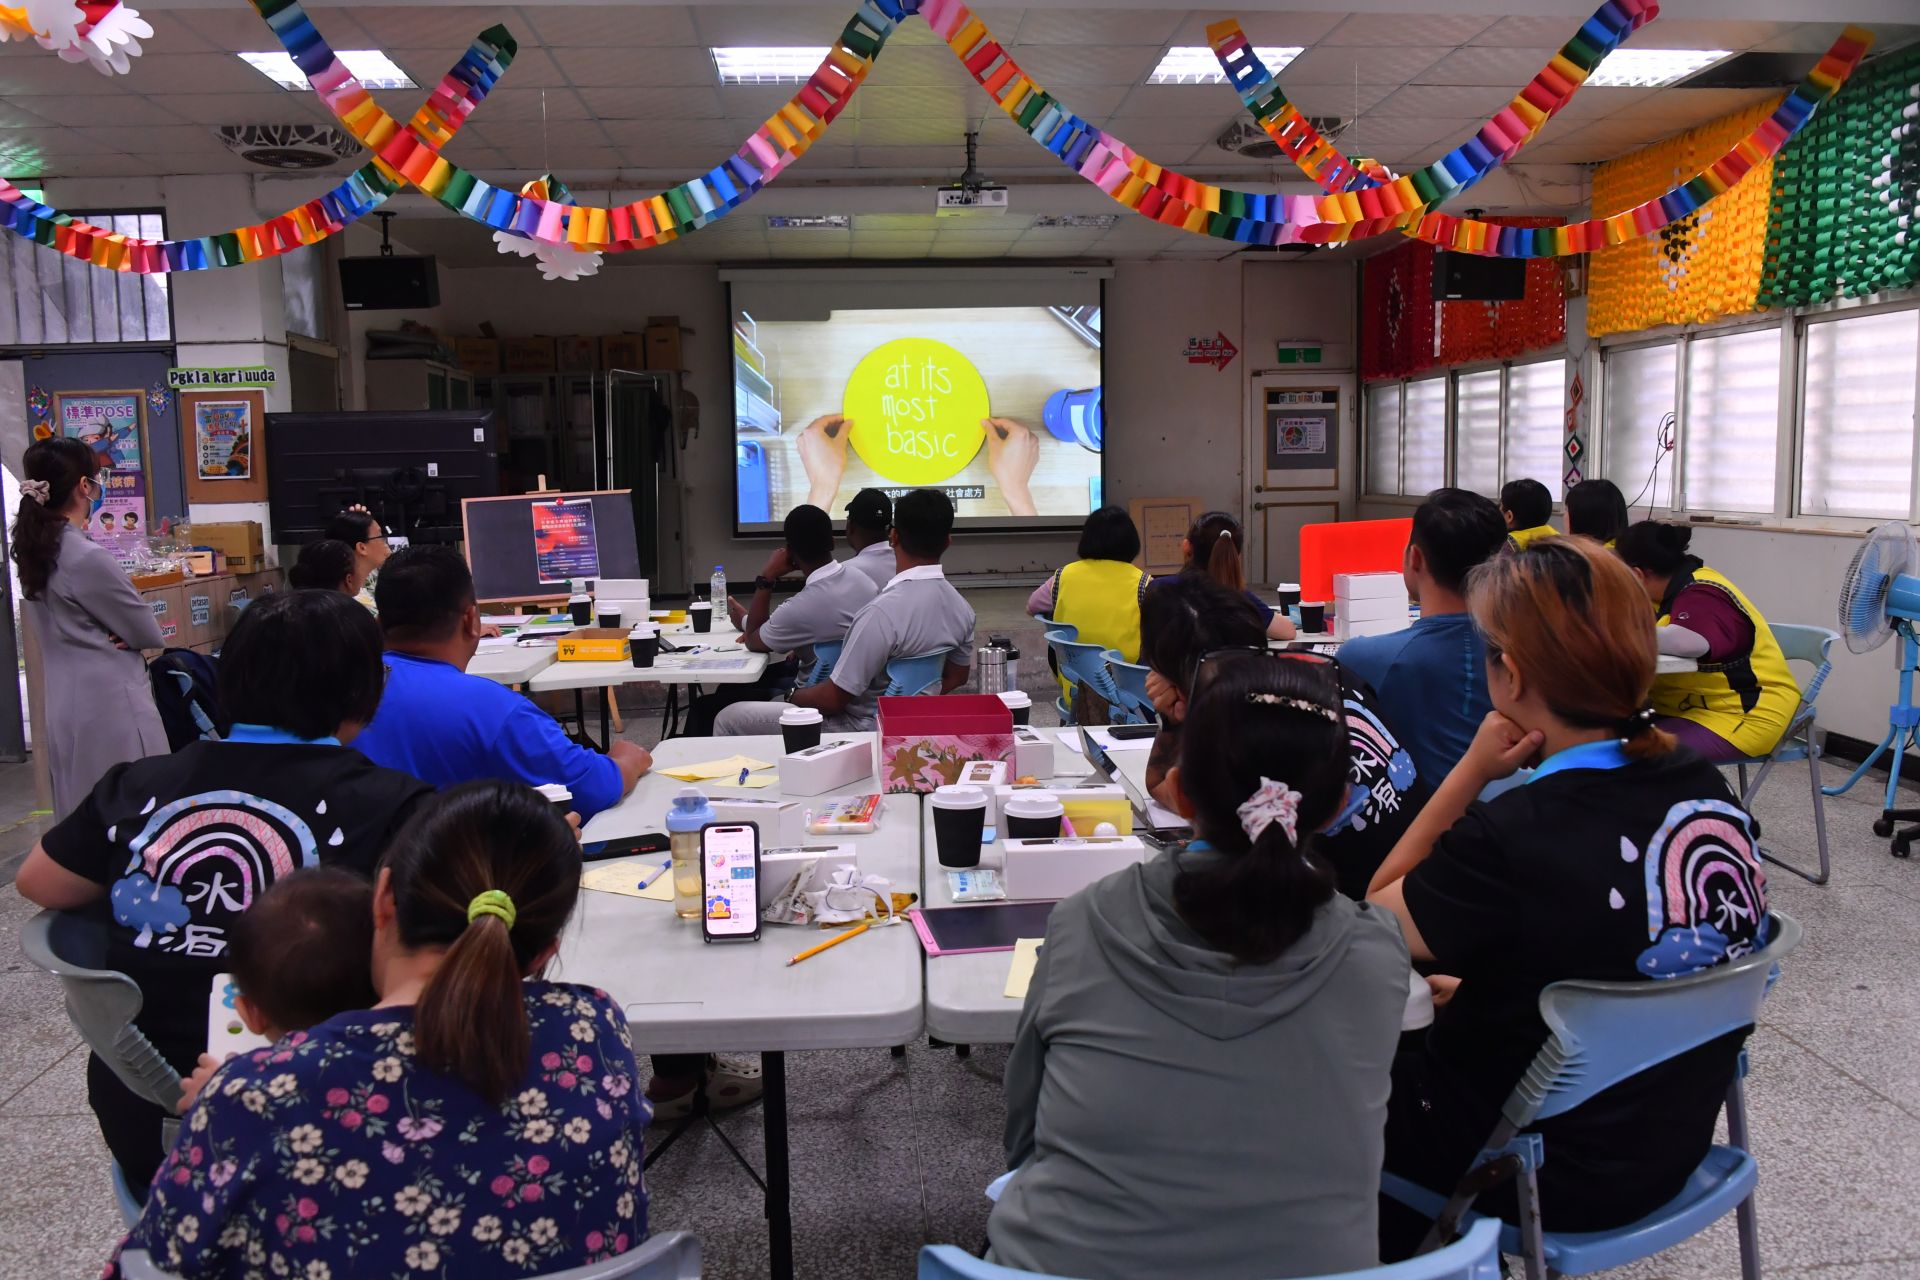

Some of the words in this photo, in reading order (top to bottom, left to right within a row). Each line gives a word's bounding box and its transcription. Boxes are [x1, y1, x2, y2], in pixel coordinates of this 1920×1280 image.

[170, 370, 209, 385] Pgkla
[884, 353, 912, 390] at
[920, 356, 952, 394] its
[882, 395, 937, 426] most
[887, 422, 958, 459] basic
